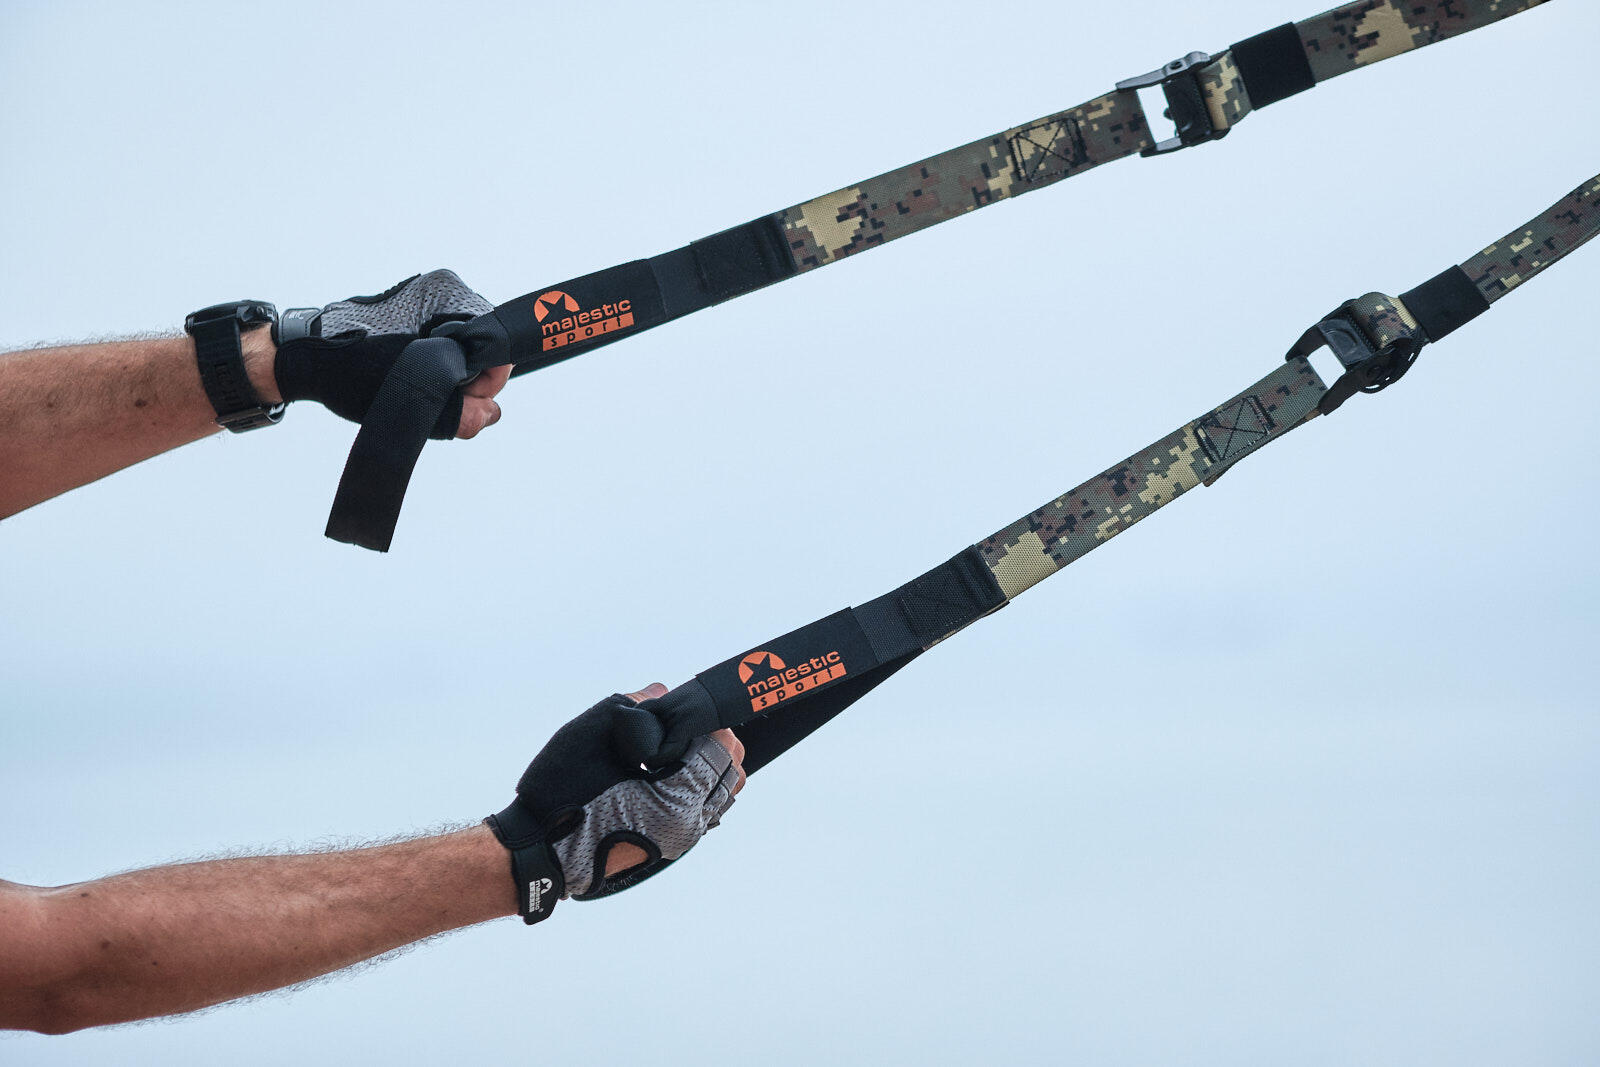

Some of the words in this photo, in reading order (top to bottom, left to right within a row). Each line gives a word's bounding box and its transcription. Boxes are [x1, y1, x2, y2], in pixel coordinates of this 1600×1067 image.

[541, 299, 632, 336] majestic
[550, 315, 622, 347] sport
[747, 650, 841, 696] majestic
[759, 667, 833, 707] sport
